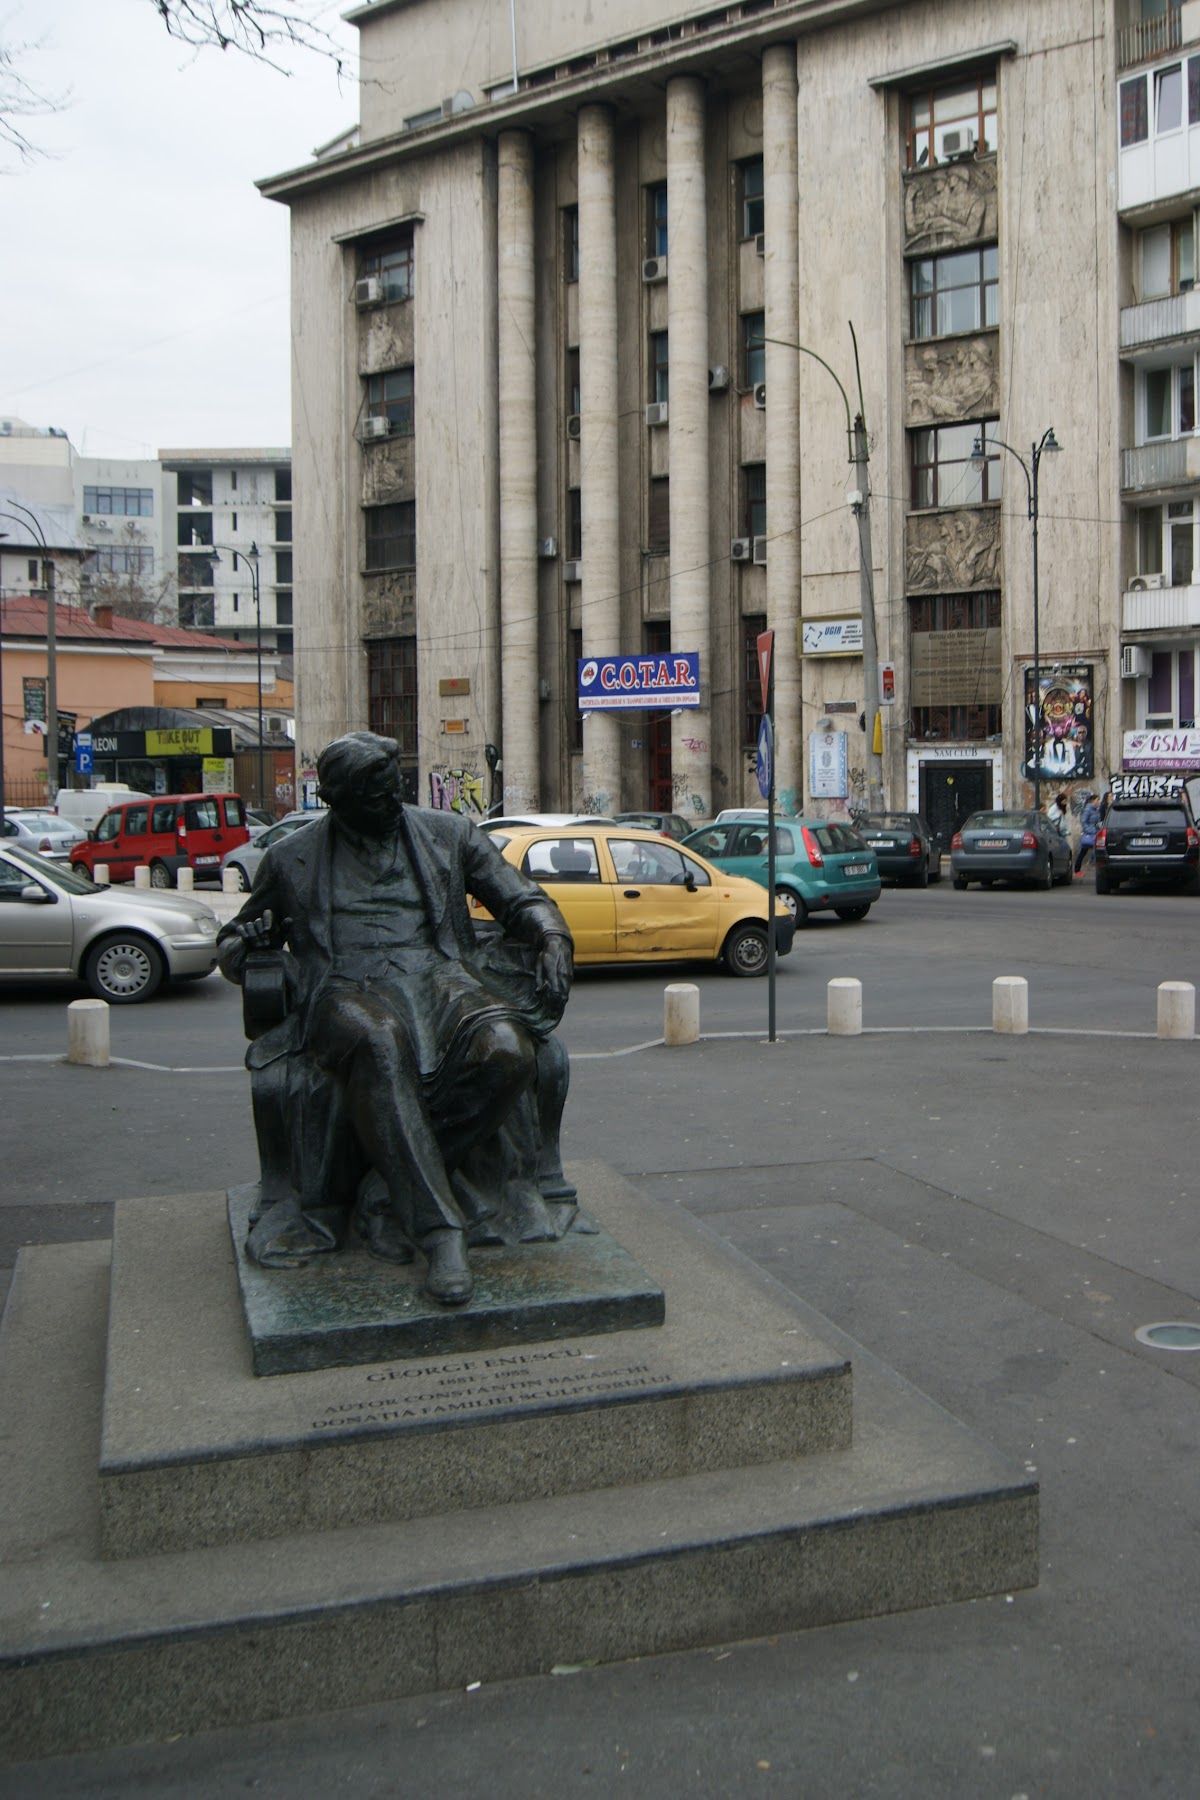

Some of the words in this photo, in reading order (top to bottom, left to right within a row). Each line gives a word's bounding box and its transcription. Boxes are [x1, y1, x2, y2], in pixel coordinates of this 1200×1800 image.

[601, 659, 696, 690] C.O.T.A.R.
[934, 748, 952, 757] SAM
[954, 747, 978, 757] CLUB
[1150, 735, 1188, 752] GSM
[80, 753, 90, 771] P
[1128, 760, 1157, 768] SERVICE
[366, 1362, 477, 1382] GEORGE
[484, 1349, 582, 1367] ENESCU
[439, 1376, 475, 1386] 1881
[495, 1369, 530, 1378] 1955
[325, 1398, 398, 1413] AUTOR
[404, 1380, 542, 1402] CONSTANTIN
[548, 1365, 648, 1384] BARASCHI
[422, 1396, 514, 1414] FAMILIEI
[520, 1375, 671, 1400] SCULPTORULUI
